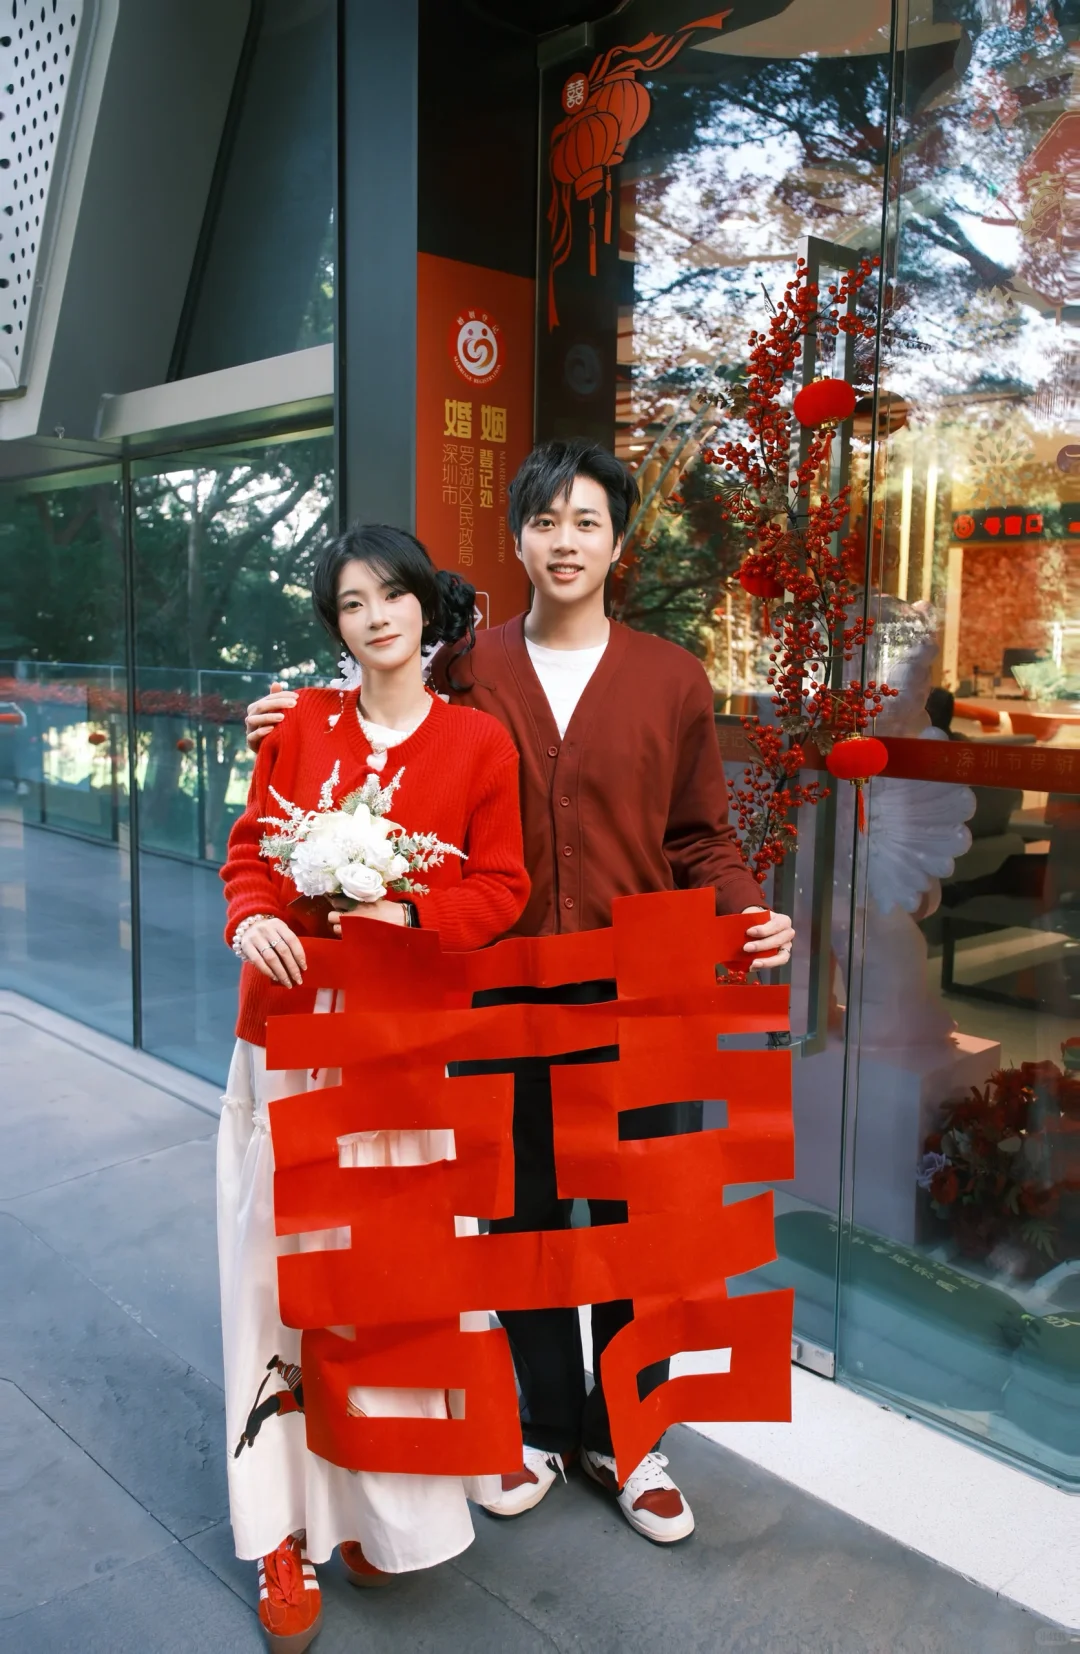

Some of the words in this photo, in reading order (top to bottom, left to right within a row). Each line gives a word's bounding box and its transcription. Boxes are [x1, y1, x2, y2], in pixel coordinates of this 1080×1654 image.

[443, 398, 507, 443] 婚姻
[442, 443, 458, 505] 深圳市
[479, 448, 494, 508] 登记处
[458, 445, 475, 567] 罗湖区民政局
